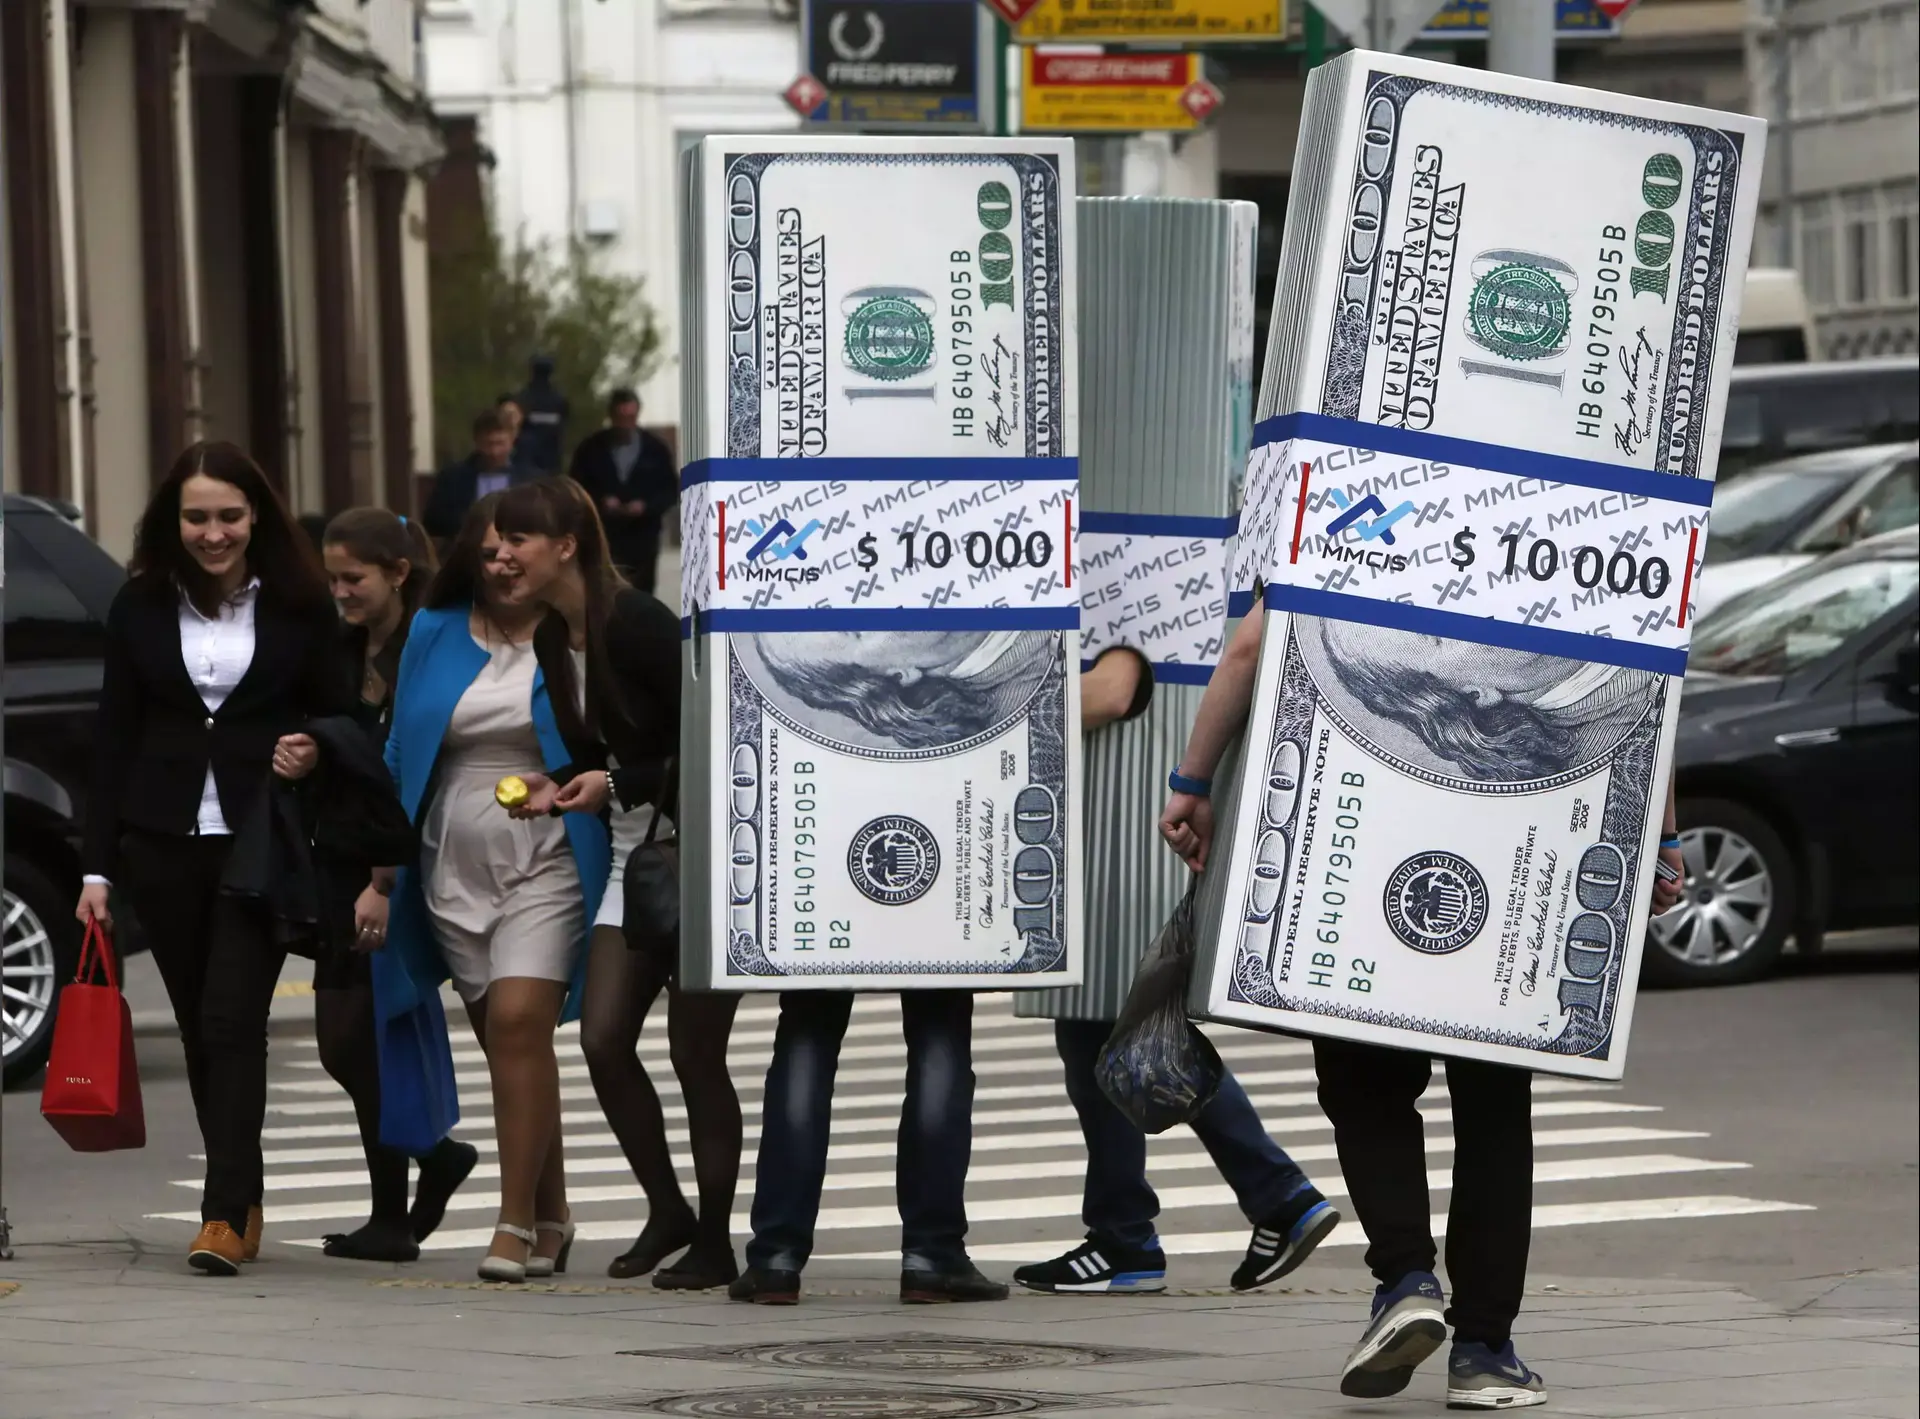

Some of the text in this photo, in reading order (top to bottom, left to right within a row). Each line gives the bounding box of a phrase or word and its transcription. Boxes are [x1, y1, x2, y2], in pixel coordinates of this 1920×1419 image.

[1030, 171, 1047, 310] DOLLARS
[1624, 150, 1687, 304] 100
[1686, 150, 1726, 307] DOLLARS
[977, 180, 1014, 311] 100
[950, 249, 973, 436] HB 64079505 B
[1575, 223, 1627, 438] HB 64079505 B
[1011, 390, 1019, 398] of
[1646, 394, 1657, 404] of
[1647, 382, 1657, 394] the
[1010, 401, 1019, 429] Secretary
[1641, 405, 1656, 438] Secretary
[858, 532, 879, 573] $
[899, 531, 952, 569] 10
[965, 531, 1052, 569] 000
[1322, 543, 1408, 572] MMCIS
[1450, 526, 1477, 572] $
[1500, 533, 1559, 582] 10
[1573, 546, 1670, 600] 000
[746, 567, 820, 582] MMCIS
[1138, 599, 1224, 646] MMCIS
[1569, 797, 1582, 833] SERIES
[1579, 803, 1590, 829] 2006
[768, 728, 777, 952] FEDERAL RESERVE NOTE
[794, 761, 815, 950] HB 64079505 B
[1001, 833, 1009, 856] United
[1278, 728, 1330, 983] FEDERAL RESERVE NOTE
[1523, 824, 1537, 864] PRIVATE
[1001, 859, 1009, 868] the
[1001, 868, 1010, 876] of
[1013, 782, 1057, 940] 100
[1307, 770, 1365, 987] HB 64079505 B
[1520, 867, 1529, 887] AND
[1001, 878, 1009, 908] Treasurer
[1389, 861, 1420, 937] UNITED STATES
[1418, 856, 1483, 949] FEDERAL RESERVE SYSTEM
[1513, 889, 1526, 926] PUBLIC
[1556, 892, 1569, 919] United
[1494, 845, 1524, 983] THIS NOTE IS LEGAL TENDER
[1554, 921, 1564, 932] the
[1554, 838, 1631, 1021] 100
[1552, 931, 1564, 942] of
[1347, 957, 1376, 993] B2
[1502, 966, 1513, 984] ALL
[1546, 942, 1561, 979] Treasurer
[1499, 986, 1509, 1006] FOR
[1536, 1020, 1548, 1031] A
[65, 1076, 92, 1085] FURLA
